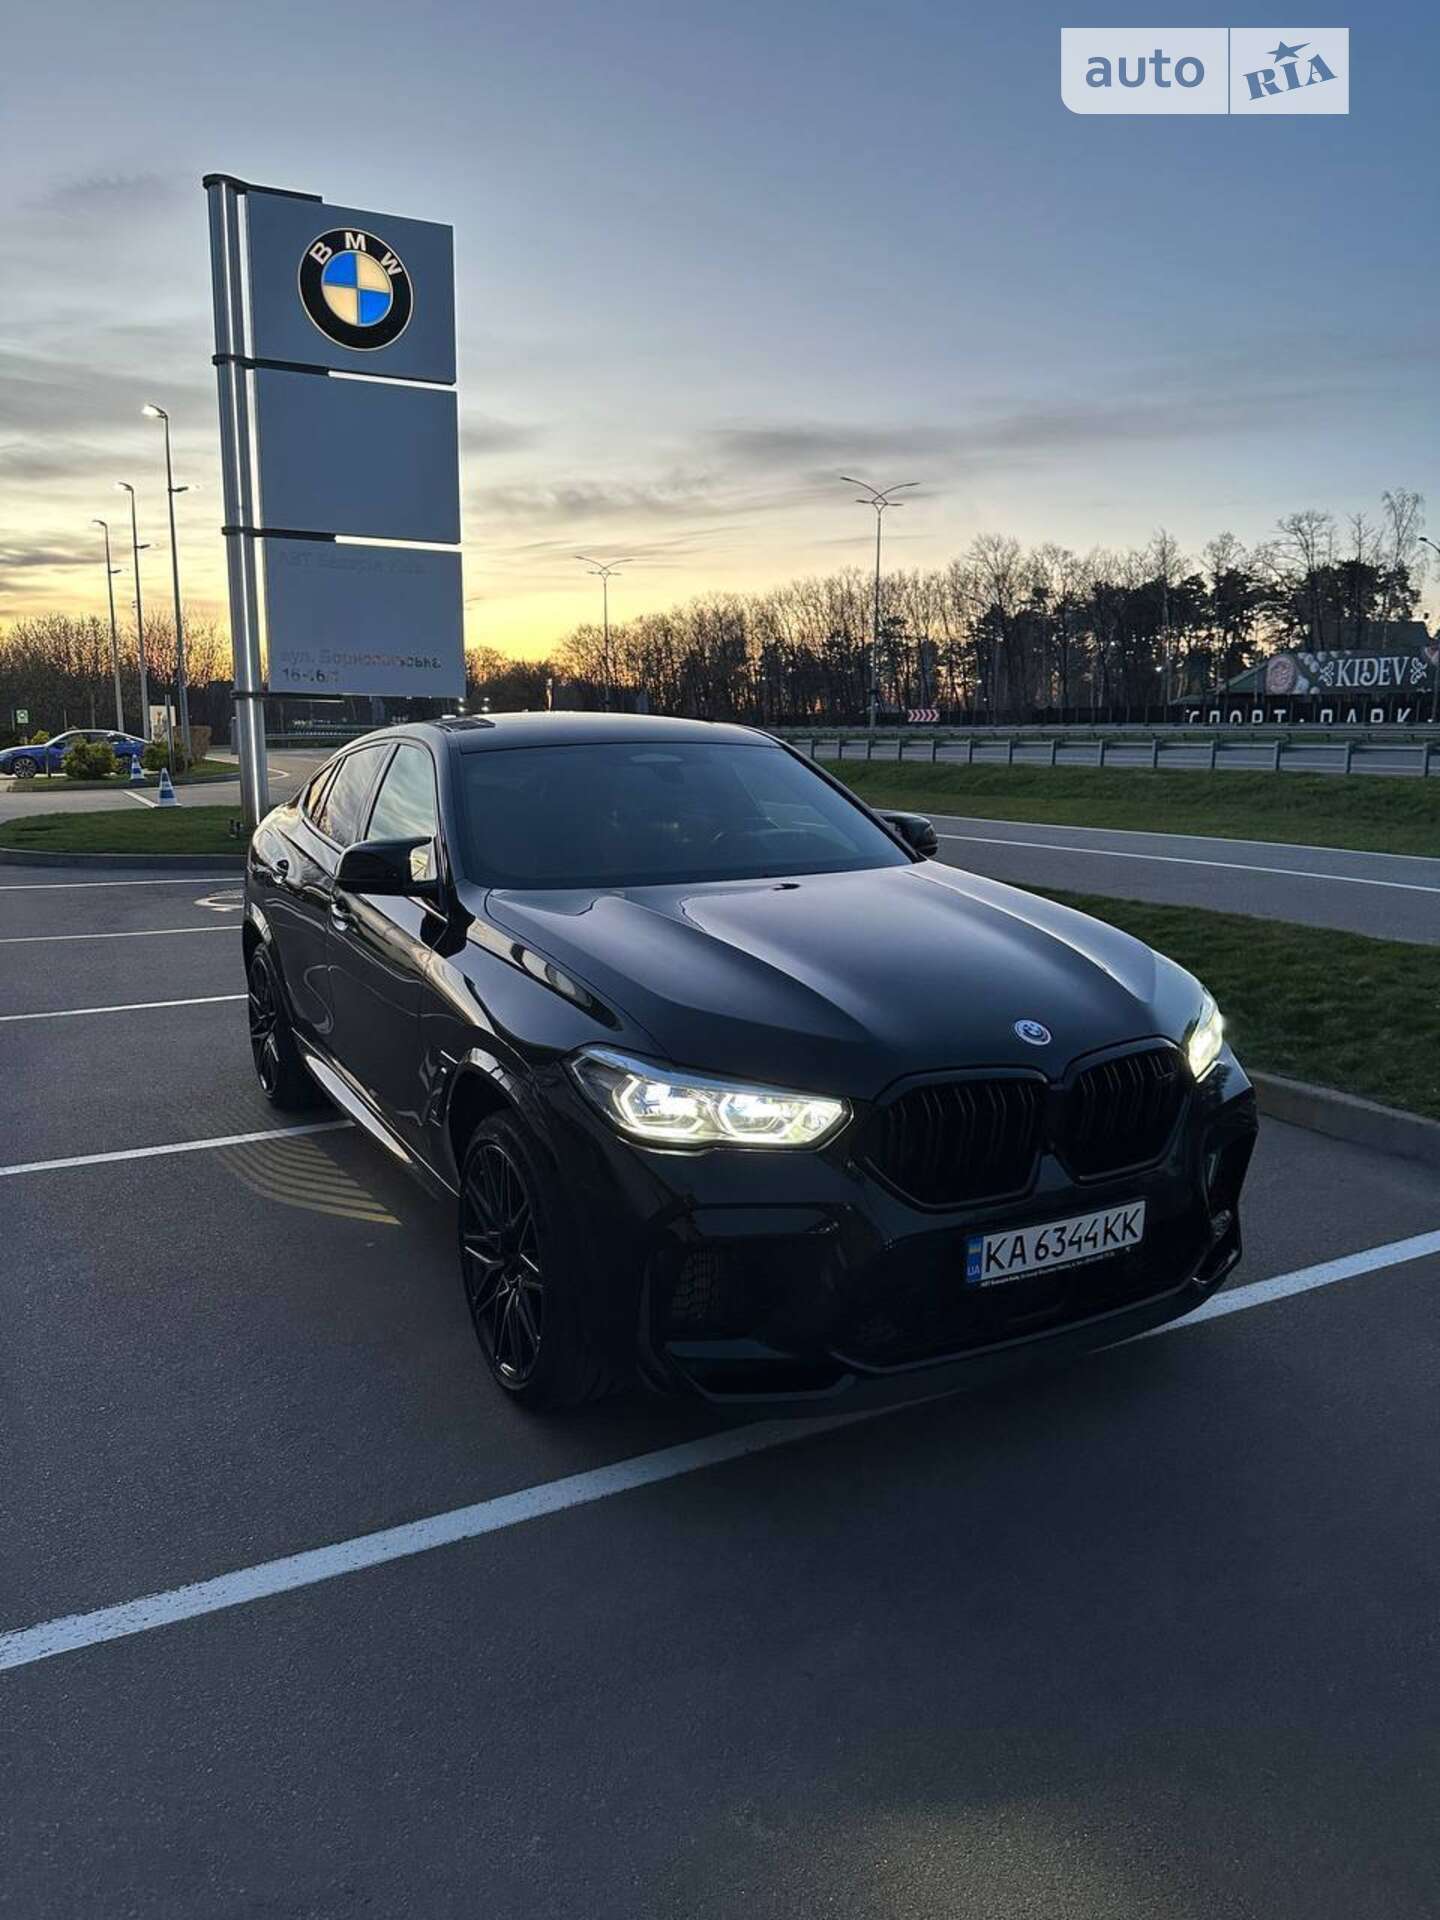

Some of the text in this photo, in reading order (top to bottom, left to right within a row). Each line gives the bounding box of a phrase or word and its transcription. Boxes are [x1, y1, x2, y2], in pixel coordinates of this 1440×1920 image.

[309, 231, 402, 277] BMW
[985, 1235, 1027, 1273] KA
[1034, 1219, 1098, 1261] 6344
[1103, 1207, 1142, 1246] KK
